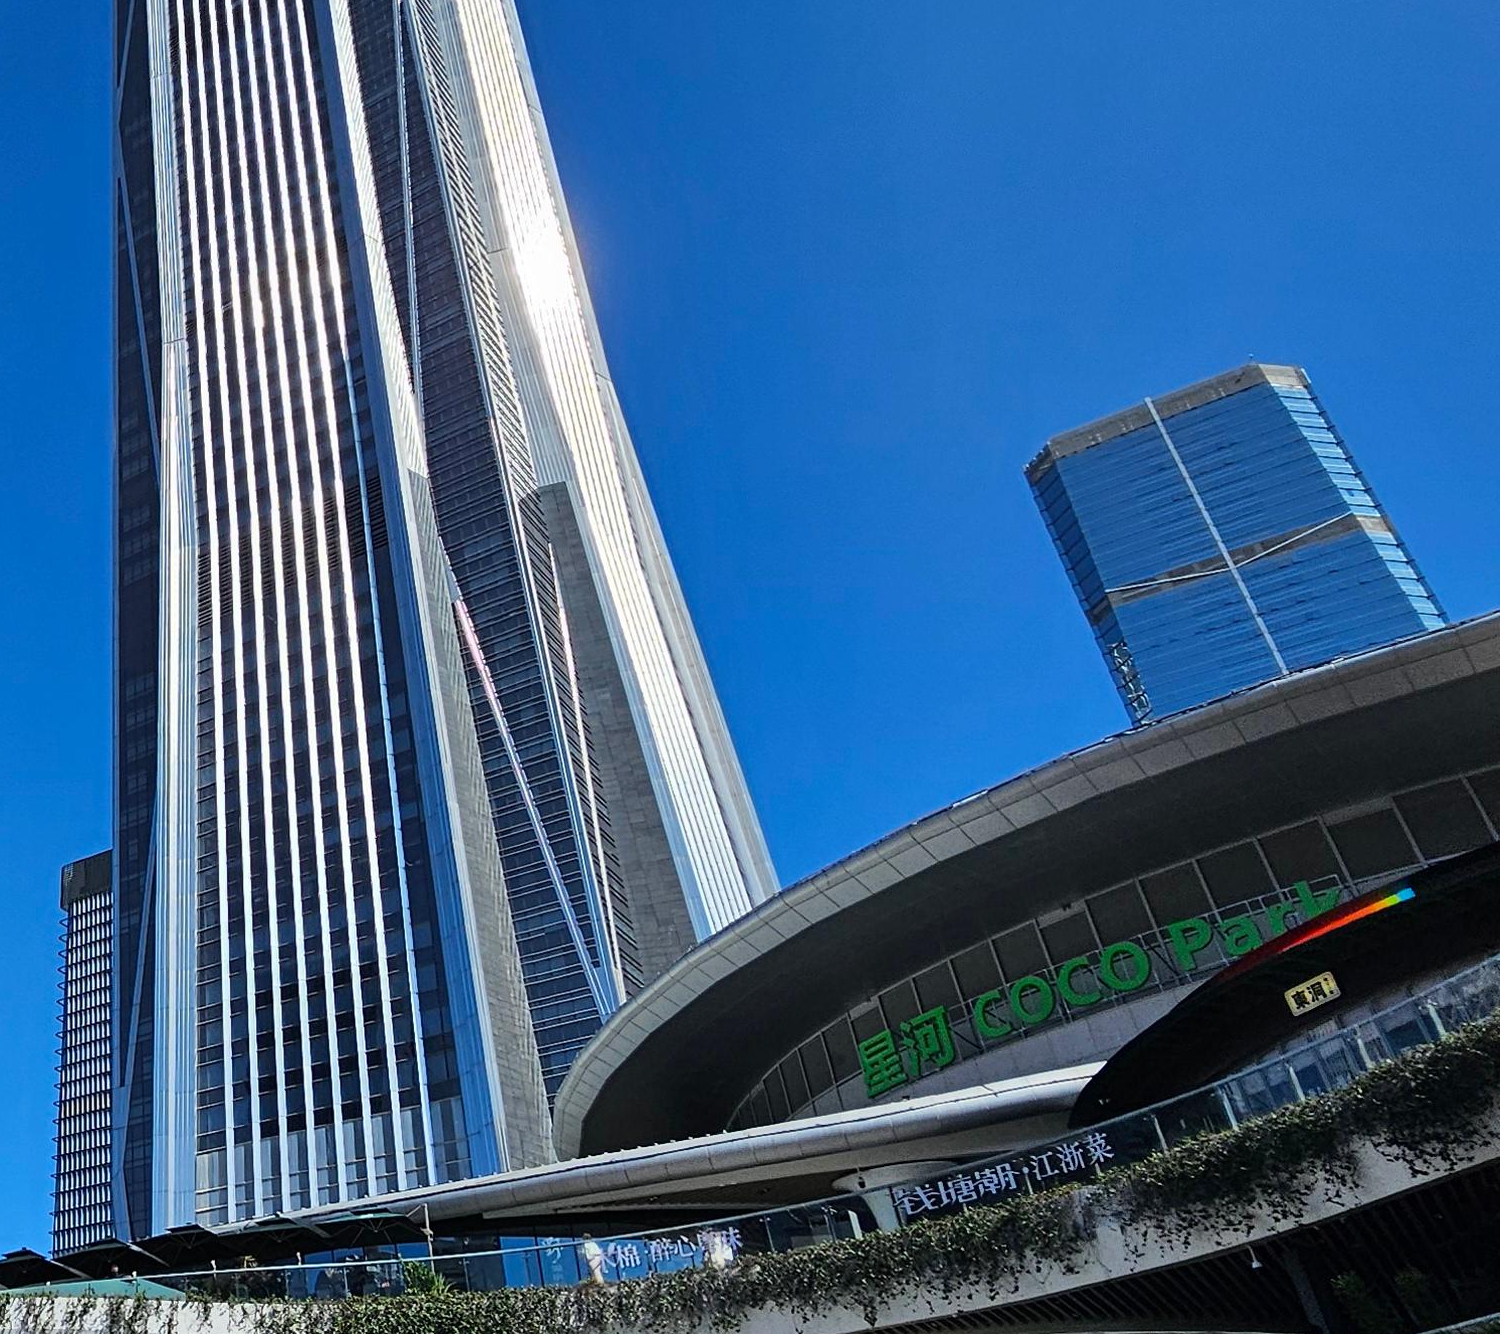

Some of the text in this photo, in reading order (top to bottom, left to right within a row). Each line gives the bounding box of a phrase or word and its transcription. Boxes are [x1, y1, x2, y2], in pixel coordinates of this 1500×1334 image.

[858, 880, 1343, 1100] 星河 COCO Park
